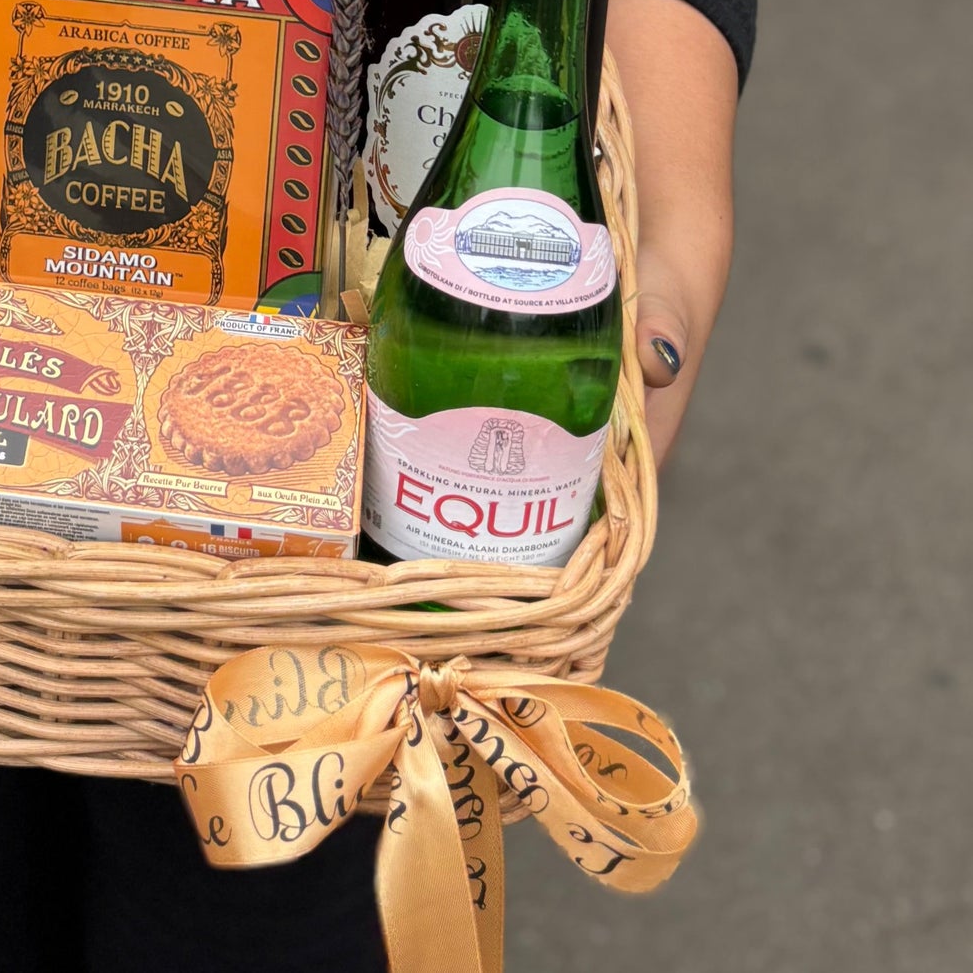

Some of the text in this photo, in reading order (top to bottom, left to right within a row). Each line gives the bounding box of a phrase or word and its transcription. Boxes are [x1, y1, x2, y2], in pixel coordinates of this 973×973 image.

[58, 25, 190, 51] ARABICA COFFEE
[96, 81, 149, 105] 1910
[439, 91, 464, 100] SPECI
[83, 99, 160, 116] MARRAKECH
[417, 105, 455, 127] Ch
[43, 119, 189, 203] BACHA
[65, 181, 166, 214] COFFEE
[63, 245, 156, 268] SIDAMO
[45, 259, 173, 286] MOUNTAIN
[55, 277, 65, 285] 12
[67, 278, 99, 289] coffee
[101, 281, 126, 293] bags
[468, 289, 501, 303] BOTTLED
[514, 299, 543, 307] SOURCE
[555, 298, 574, 306] VILLA
[215, 320, 255, 332] PRODUCT
[269, 326, 302, 336] FRANCE
[142, 475, 223, 493] Recette Pur Beurre
[397, 458, 450, 486] SPARKLING
[454, 482, 503, 496] NATURAL
[508, 488, 552, 496] MINERAL
[257, 491, 273, 499] aux
[299, 494, 321, 505] Plein
[322, 497, 338, 507] Air
[394, 471, 574, 538] EQUIL
[406, 524, 560, 553] AIR MINERAL ALAMI DIKARBONASI
[219, 545, 260, 557] BISCUITS
